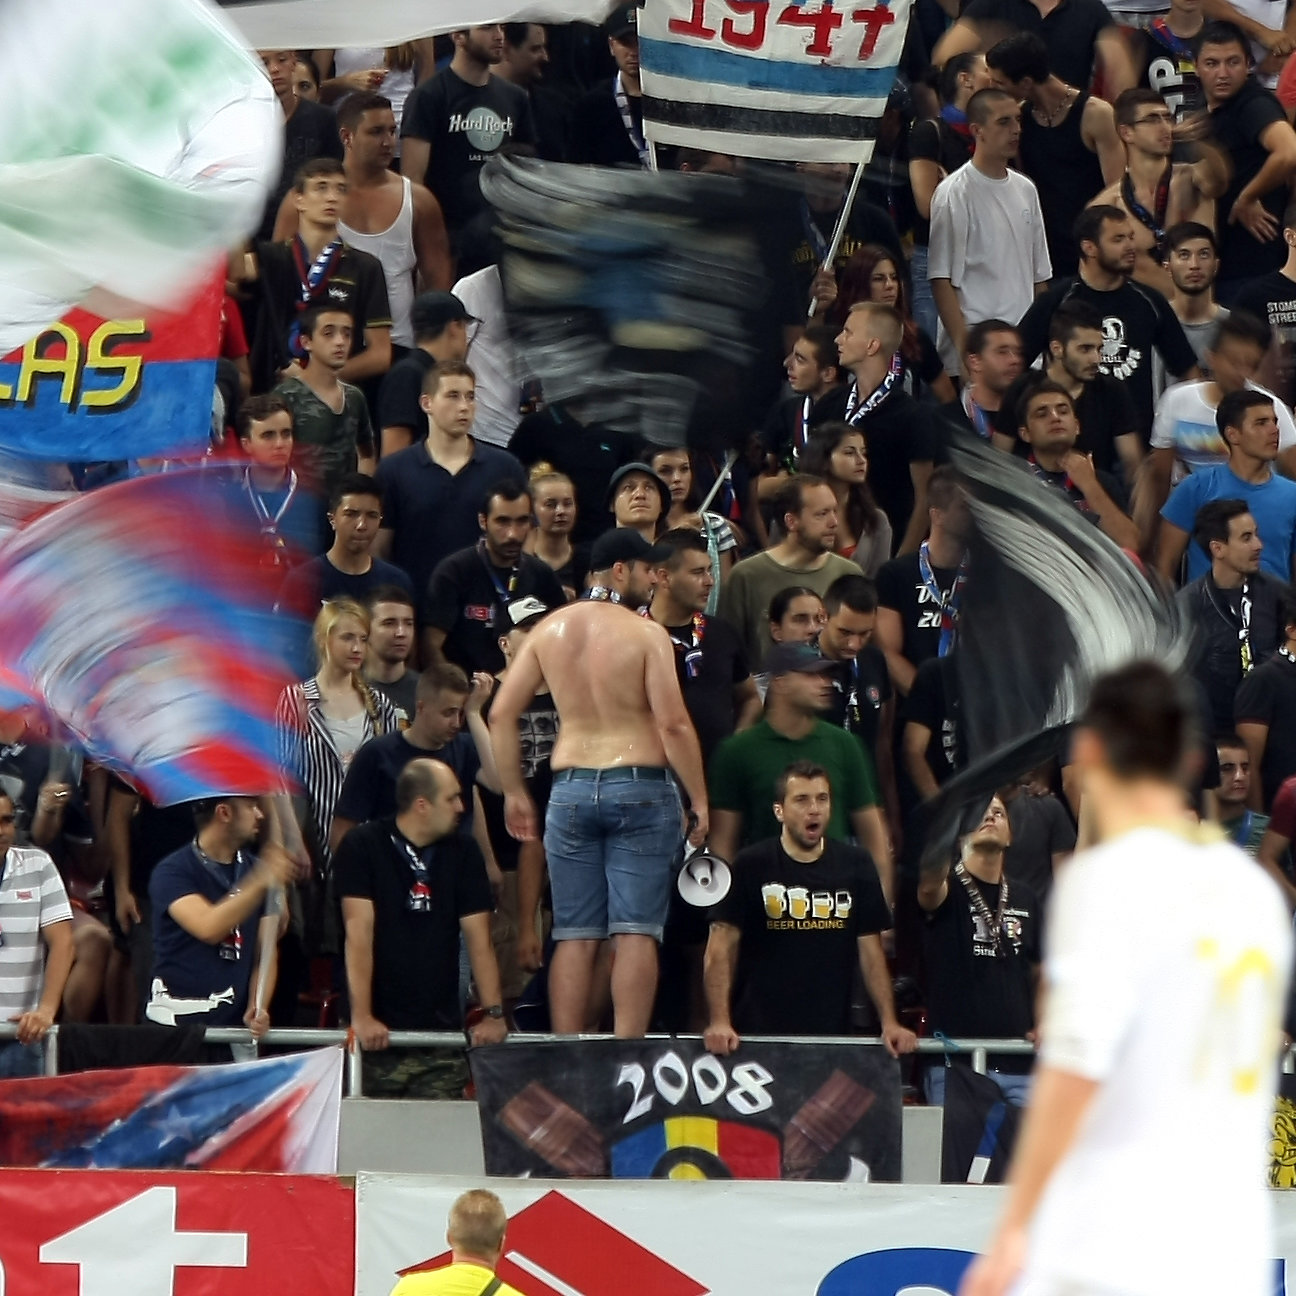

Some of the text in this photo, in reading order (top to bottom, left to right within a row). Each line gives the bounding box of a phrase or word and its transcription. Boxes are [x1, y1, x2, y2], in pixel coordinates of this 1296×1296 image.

[448, 114, 513, 137] Hard Rock
[766, 920, 796, 930] BEER
[616, 1050, 775, 1124] 2008
